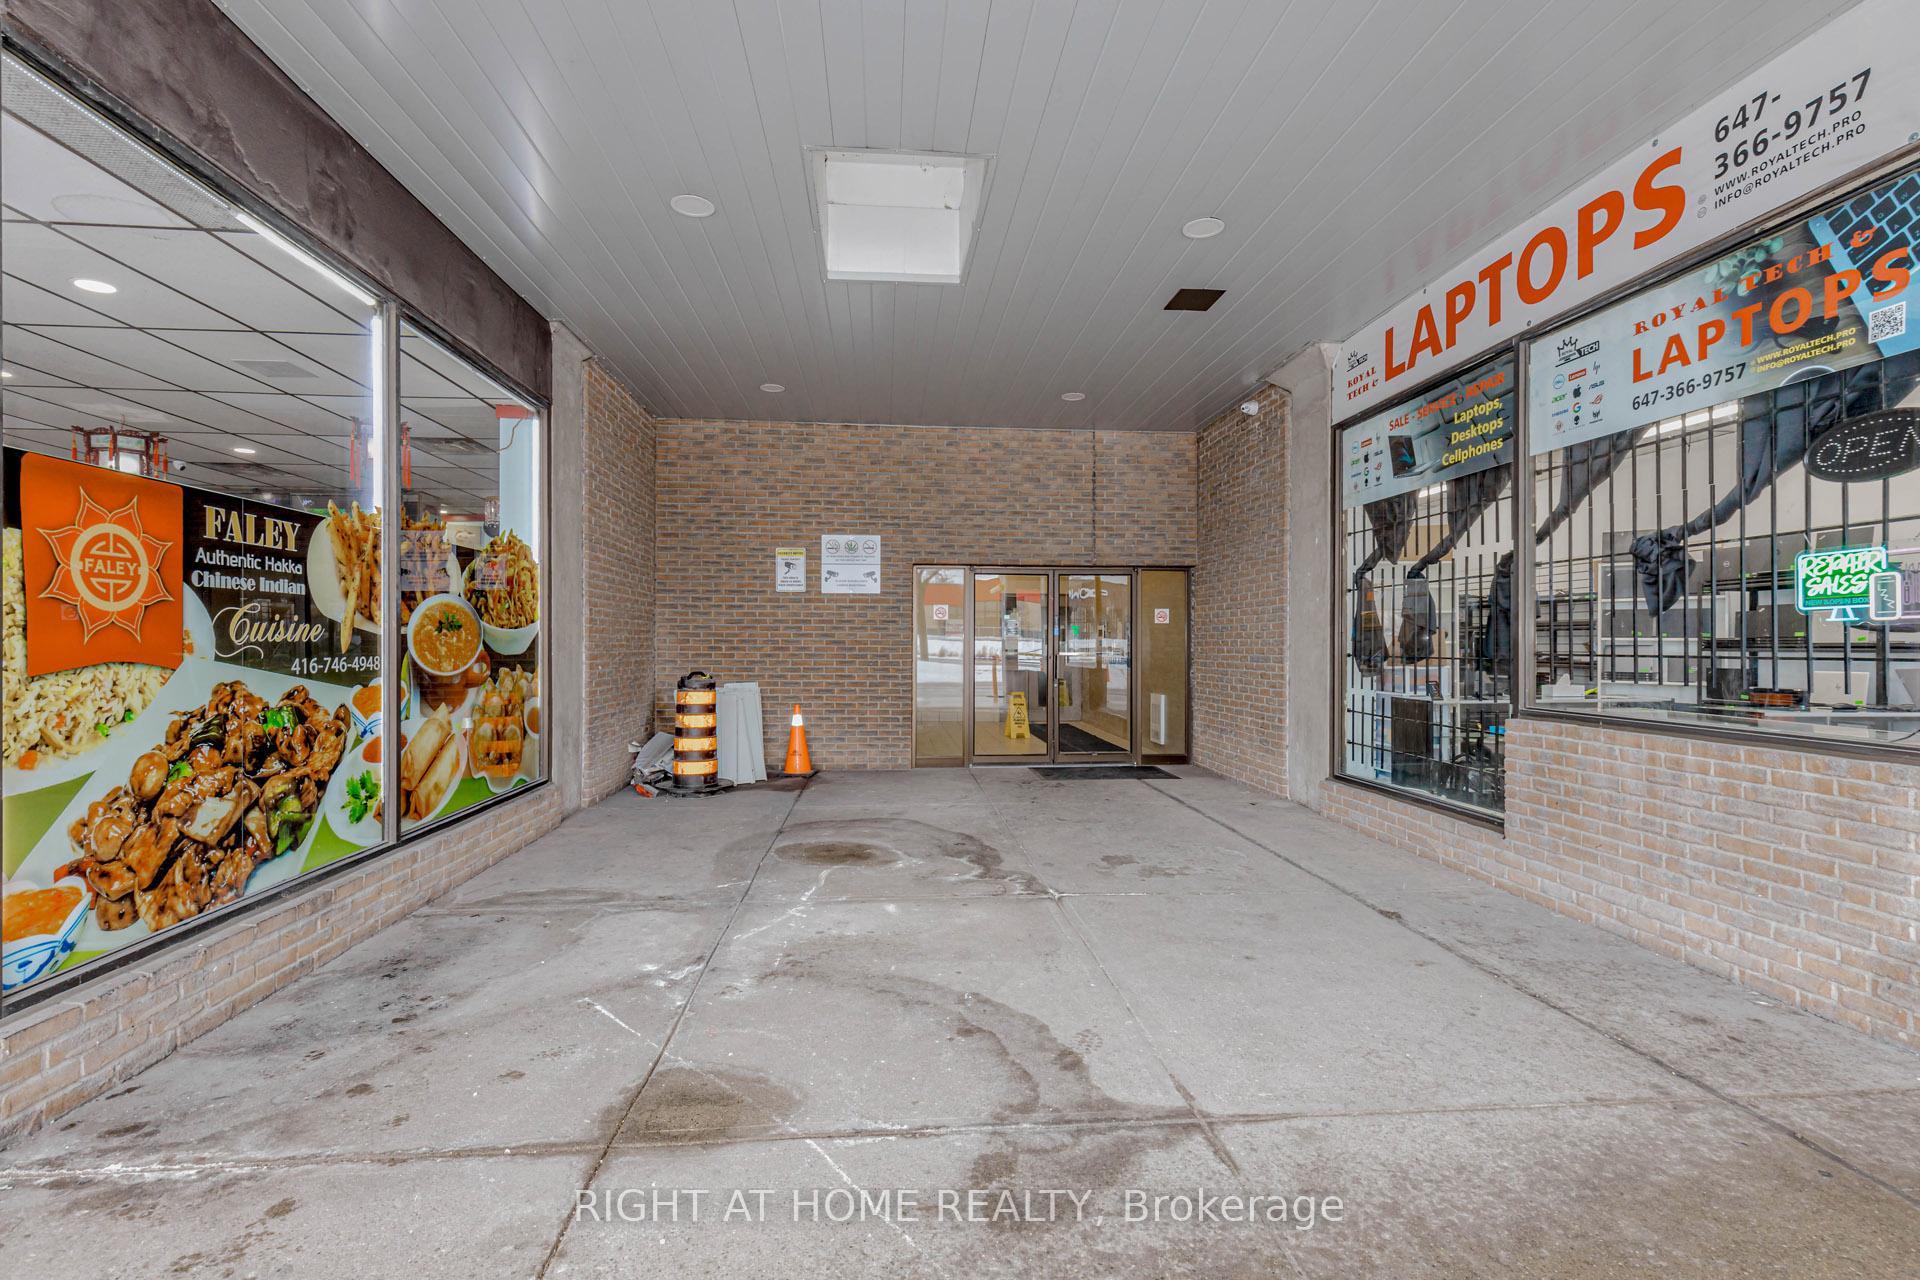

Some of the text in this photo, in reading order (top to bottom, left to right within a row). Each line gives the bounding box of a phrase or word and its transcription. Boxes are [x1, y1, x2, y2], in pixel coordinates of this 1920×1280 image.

[1715, 91, 1781, 143] 647-
[1715, 67, 1871, 180] 366-9757
[1714, 110, 1862, 195] WWW.ROYALTECH.PRO
[1714, 123, 1866, 209] INFO@ROYALTECH.PRO
[1384, 146, 1686, 382] LAPTOPS
[1633, 225, 1877, 336] ROYAL TECH &
[1632, 246, 1911, 383] LAPTOPS
[1581, 342, 1599, 356] TECH
[1756, 327, 1856, 364] WWW.ROYALTECH.PRO
[1756, 337, 1856, 373] INFO@ROYALTECH.PRO
[1347, 384, 1369, 401] TECH
[1389, 413, 1409, 431] SALE
[1416, 392, 1456, 420] SERVICE
[1466, 371, 1505, 399] REPAIR
[1632, 362, 1747, 410] 647-366-9757
[1454, 397, 1503, 425] Laptops,
[1451, 416, 1504, 445] Desktops
[1442, 437, 1503, 466] Cellphones
[203, 505, 301, 552] FALEY
[84, 557, 138, 576] FALEY
[195, 547, 303, 575] Authentic Hakka
[1801, 551, 1882, 578] REPAIR
[191, 570, 305, 595] Chinese Indian
[1805, 573, 1869, 596] SALES
[218, 603, 325, 652] Cuisine
[291, 655, 381, 675] 416-746-4948
